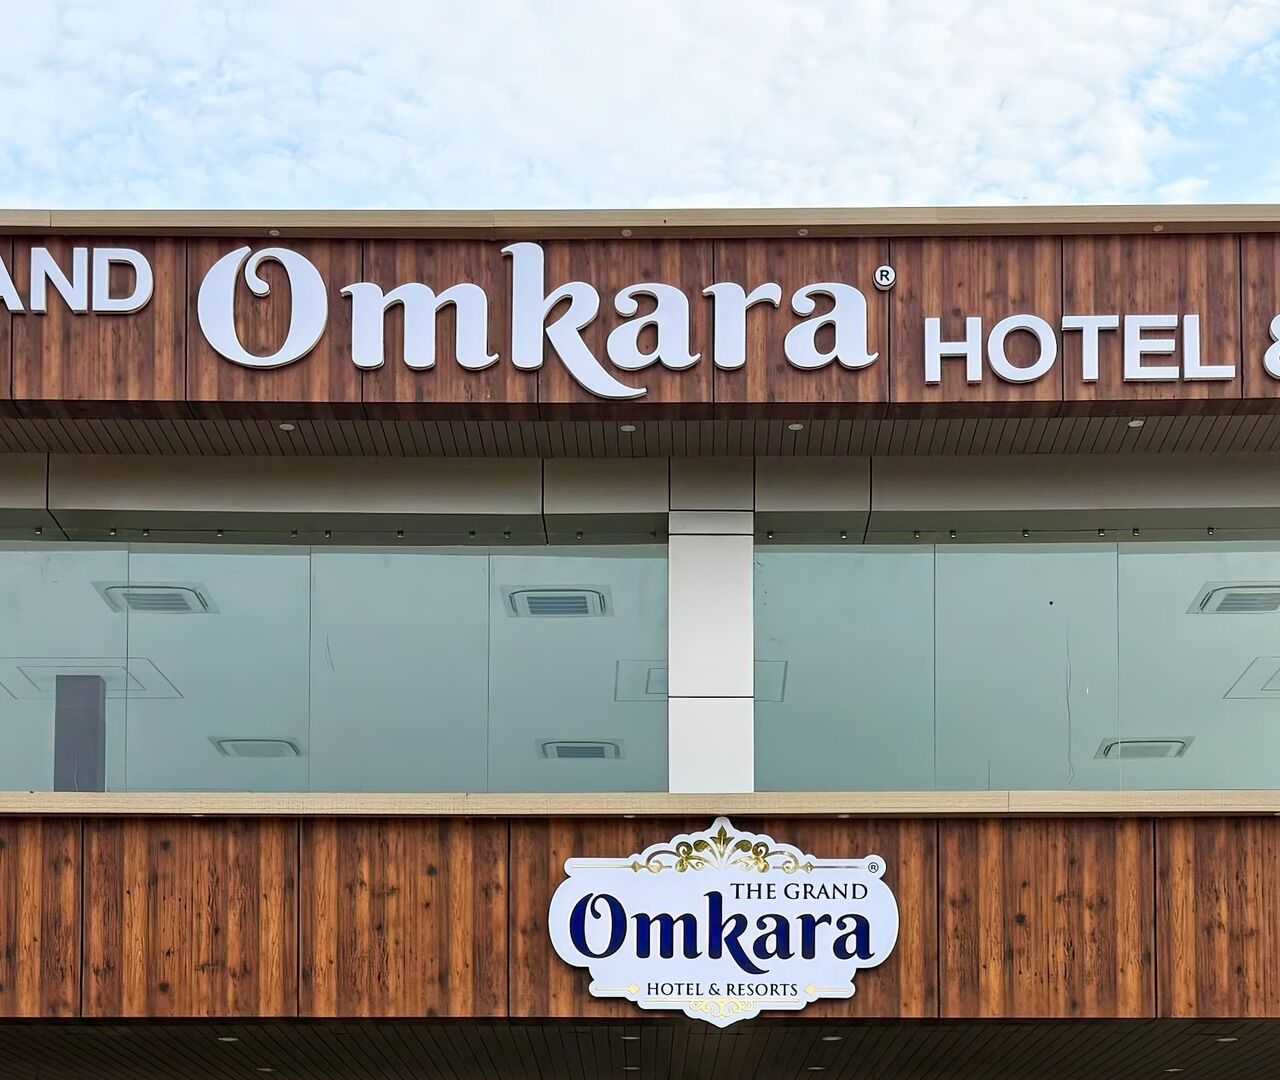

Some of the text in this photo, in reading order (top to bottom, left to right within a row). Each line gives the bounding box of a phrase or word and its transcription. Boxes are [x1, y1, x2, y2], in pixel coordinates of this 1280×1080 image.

[196, 241, 880, 400] Omkara
[924, 313, 1237, 384] HOTEL
[730, 882, 869, 901] THE GRAND
[569, 890, 876, 975] Omkara
[646, 982, 799, 998] HOTEL & RESORTS
